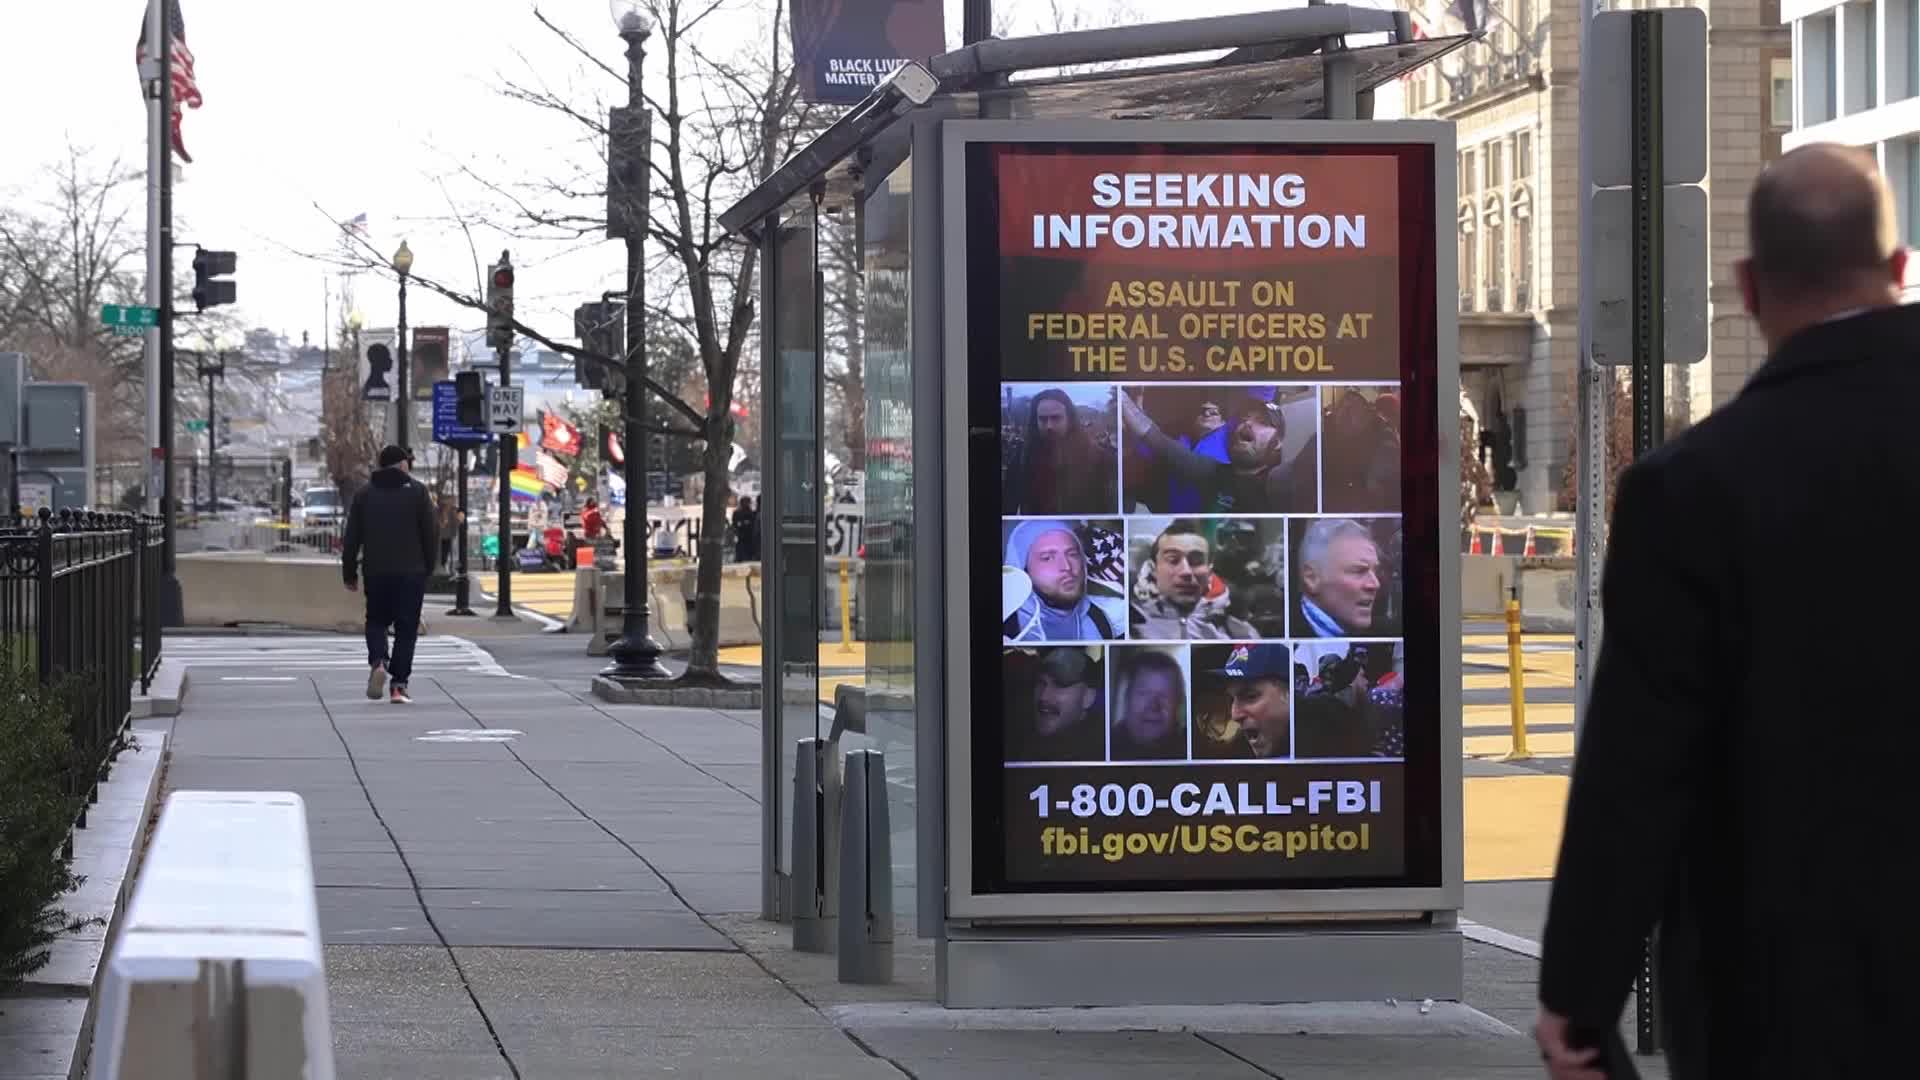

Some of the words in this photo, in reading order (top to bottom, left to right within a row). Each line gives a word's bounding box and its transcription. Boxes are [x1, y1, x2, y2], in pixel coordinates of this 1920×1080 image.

[825, 73, 876, 85] MATTER
[829, 59, 872, 72] BLACK
[1092, 173, 1306, 207] SEEKING
[1032, 215, 1367, 248] INFORMATION
[1105, 281, 1240, 307] ASSAULT
[1252, 281, 1294, 306] ON
[115, 325, 144, 337] 1500
[1027, 314, 1167, 341] FEDERAL
[1179, 313, 1326, 339] OFFICERS
[1337, 313, 1373, 338] AT
[1069, 346, 1127, 373] THE
[1138, 346, 1194, 372] U.S.
[1206, 345, 1334, 372] CAPITOL
[492, 391, 520, 402] ONE
[492, 403, 520, 415] WAY
[1028, 781, 1382, 818] 1-800-CALL-FBI
[1040, 823, 1370, 861] fbi.gov/USCapitol
